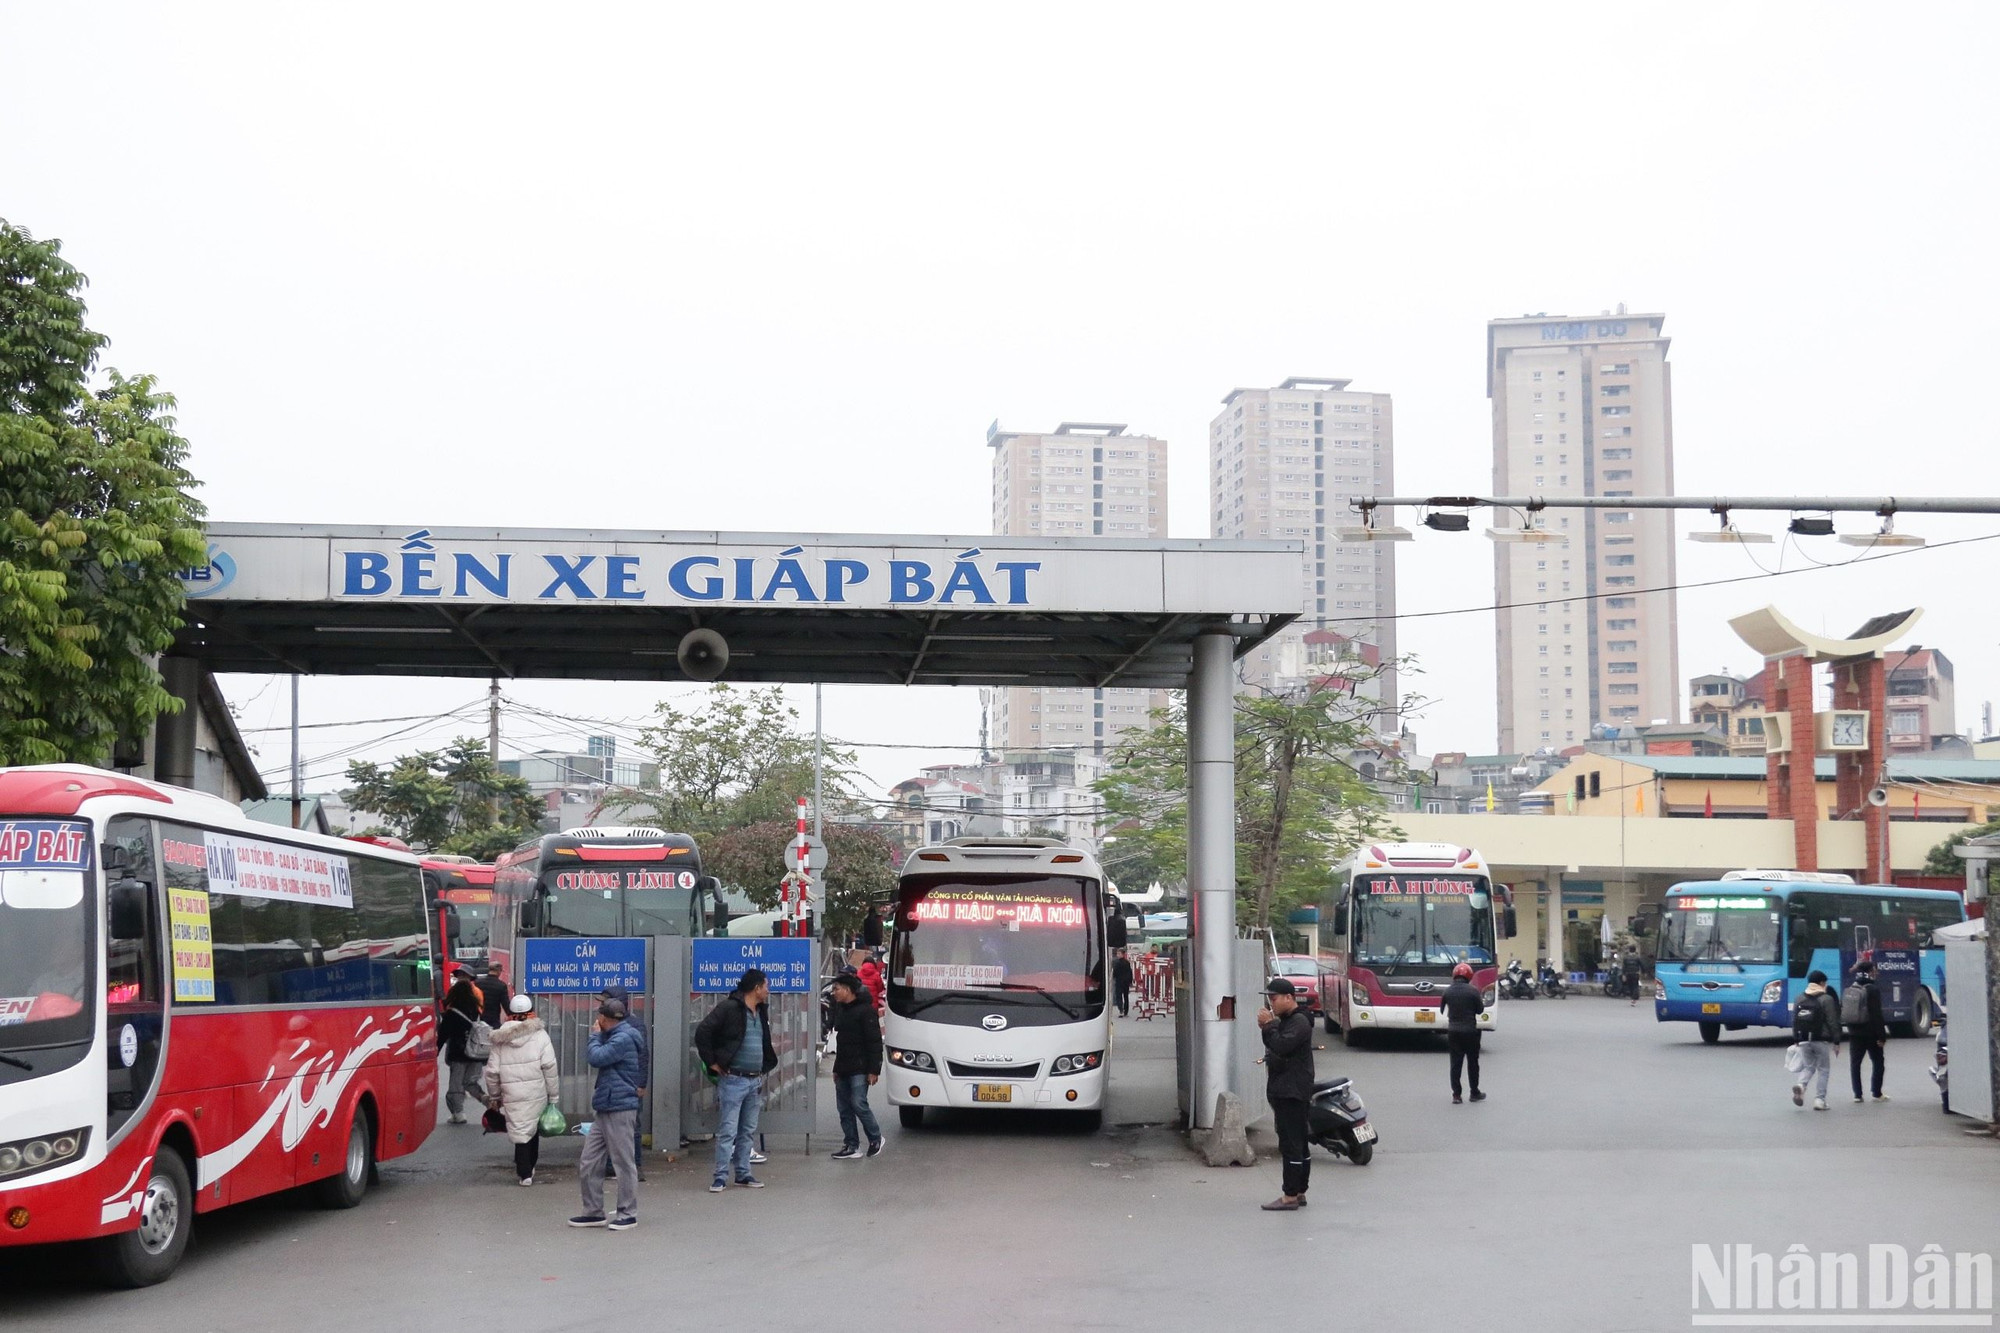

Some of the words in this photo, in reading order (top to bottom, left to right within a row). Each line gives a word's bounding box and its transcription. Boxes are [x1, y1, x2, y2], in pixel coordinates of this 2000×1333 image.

[342, 529, 513, 598] BẾN
[539, 553, 647, 600] XE
[667, 545, 870, 603] GIÁP
[888, 546, 1042, 605] BÁT
[35, 824, 86, 863] BÁT
[206, 838, 221, 880] HÀ
[220, 840, 237, 889] NỘI
[626, 868, 676, 891] LĨNH
[680, 873, 693, 888] 4
[1371, 875, 1401, 894] HÀ
[1405, 877, 1475, 895] HƯƠNG
[928, 891, 951, 900] CÔNG
[916, 900, 949, 919] HẢI
[955, 901, 995, 922] HẬU
[1017, 902, 1043, 923] HÀ
[1048, 904, 1082, 926] NỘI
[576, 940, 596, 957] CẤM
[532, 961, 551, 972] HÀNH
[555, 961, 578, 972] KHÁCH
[582, 961, 590, 972] VÀ
[593, 963, 620, 972] PHƯƠNG
[624, 961, 639, 974] TIỆN
[699, 961, 718, 972] HÀNH
[722, 961, 746, 972] KHÁCH
[760, 963, 786, 972] PHƯƠNG
[791, 961, 806, 973] TIỆN
[532, 978, 538, 987] ĐI
[543, 976, 555, 987] VÀO
[558, 976, 580, 987] ĐƯỜNG
[592, 976, 601, 987] TÔ
[604, 974, 621, 987] XUẤT
[699, 978, 706, 987] ĐI
[709, 976, 721, 987] VÀO
[770, 974, 786, 987] XUẤT
[791, 976, 805, 987] BẾN
[973, 1053, 1013, 1062] ISUZU
